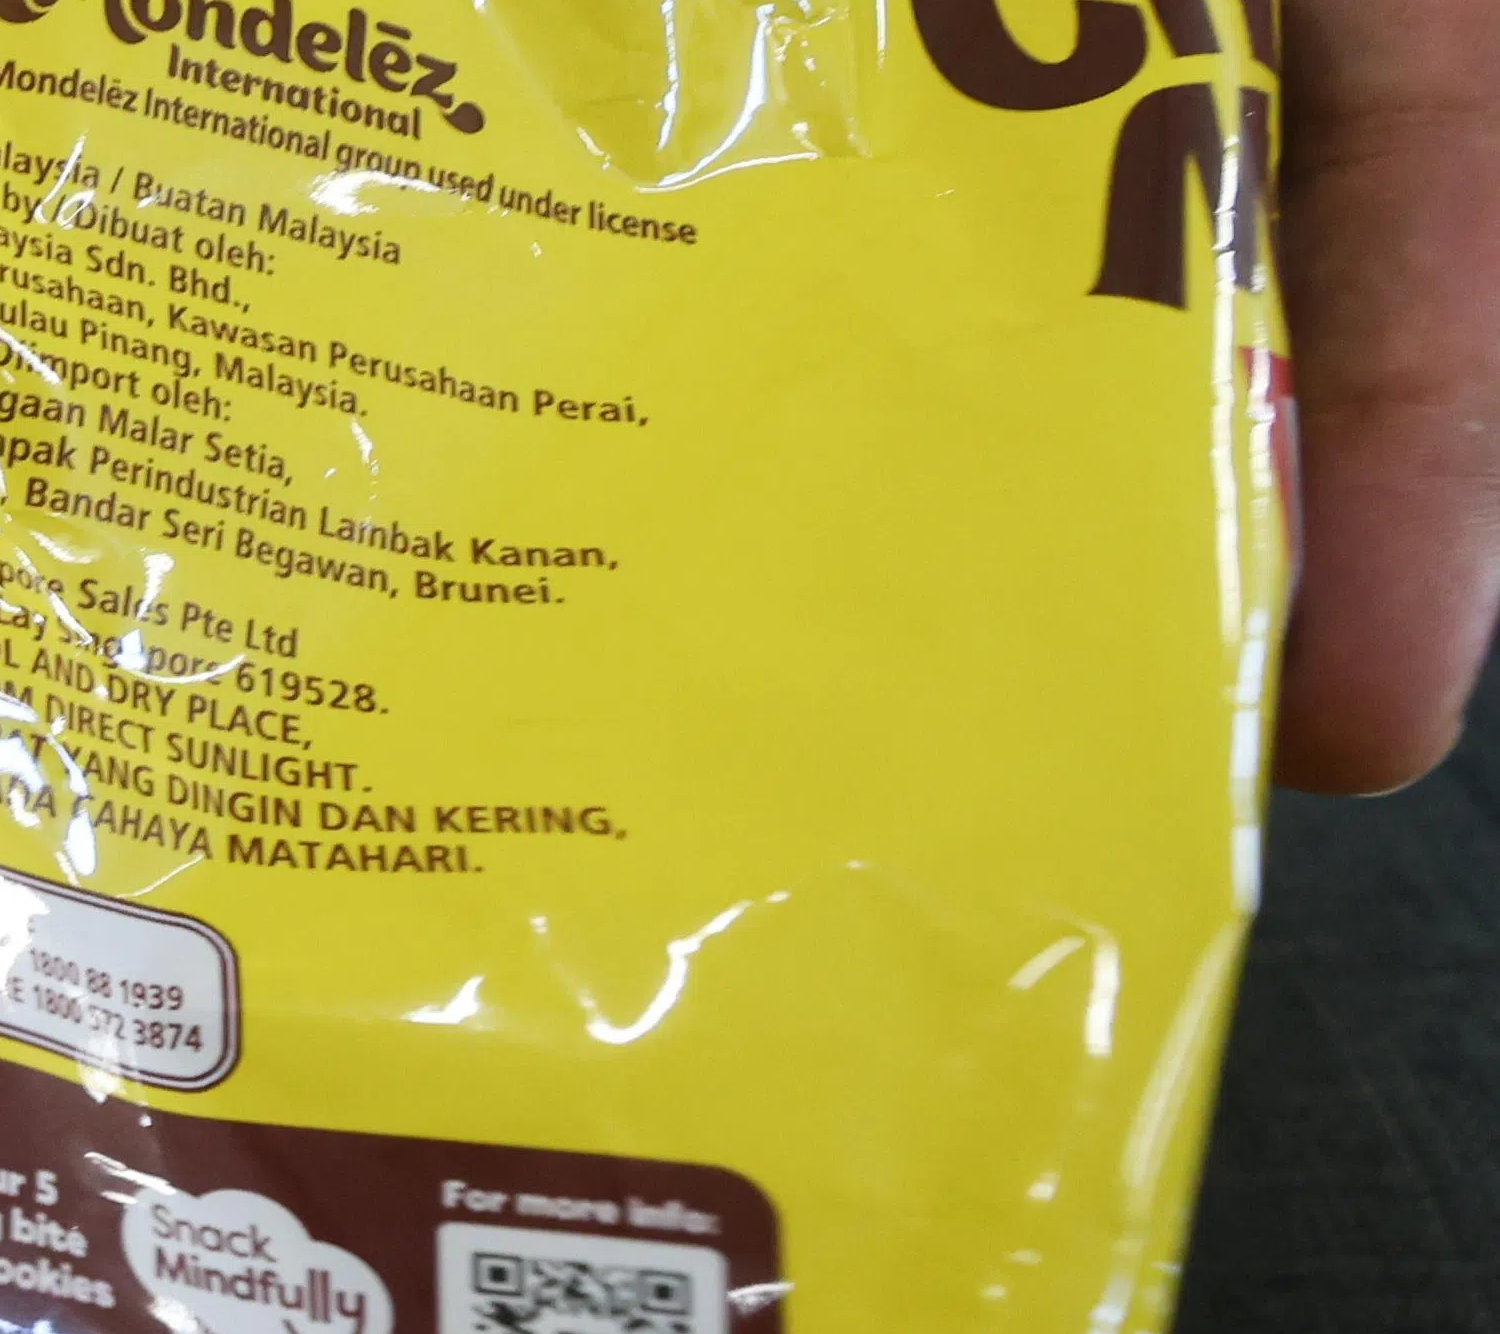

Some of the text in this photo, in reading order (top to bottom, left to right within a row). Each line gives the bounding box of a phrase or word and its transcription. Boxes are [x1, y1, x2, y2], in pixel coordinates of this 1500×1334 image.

[167, 43, 421, 140] International
[145, 88, 331, 160] International
[429, 166, 494, 203] used
[500, 189, 582, 226] under
[589, 201, 697, 245] license
[3, 181, 41, 223] by
[74, 200, 184, 253] Dibuat
[195, 234, 275, 275] oleh:
[134, 171, 246, 227] Buatan
[258, 204, 401, 265] Malaysia
[86, 245, 155, 286] Sdn.
[169, 264, 250, 313] Bhd.,
[80, 318, 200, 378] Pinang,
[215, 352, 367, 417] Malaysia.
[167, 303, 317, 362] Kawasan
[329, 341, 519, 413] Perusahaan
[534, 389, 649, 427] Perai,
[152, 379, 231, 421] oleh:
[100, 404, 194, 454] Malar
[205, 433, 292, 486] Setia,
[25, 476, 565, 603] Bandar Seri Begawan, Brunei.
[90, 445, 306, 529] Perindustrian
[319, 506, 454, 563] Lambak
[470, 538, 618, 570] Kanan,
[180, 601, 298, 659] Pte Ltd
[31, 647, 94, 693] AND
[108, 673, 175, 717] DRY
[188, 694, 313, 750] PLACE,
[236, 663, 388, 714] 619528.
[45, 694, 155, 754] DIRECT
[167, 732, 373, 793] SUNLIGHT.
[167, 774, 302, 829] DINGIN
[318, 802, 416, 833] DAN
[434, 806, 628, 840] KERING,
[227, 833, 485, 873] MATAHARI.
[119, 980, 184, 1011] 1939
[133, 1018, 204, 1052] 3874
[34, 1168, 59, 1206] 5
[441, 1180, 620, 1224] For more
[11, 1208, 88, 1258] bite
[152, 1202, 277, 1265] Snack
